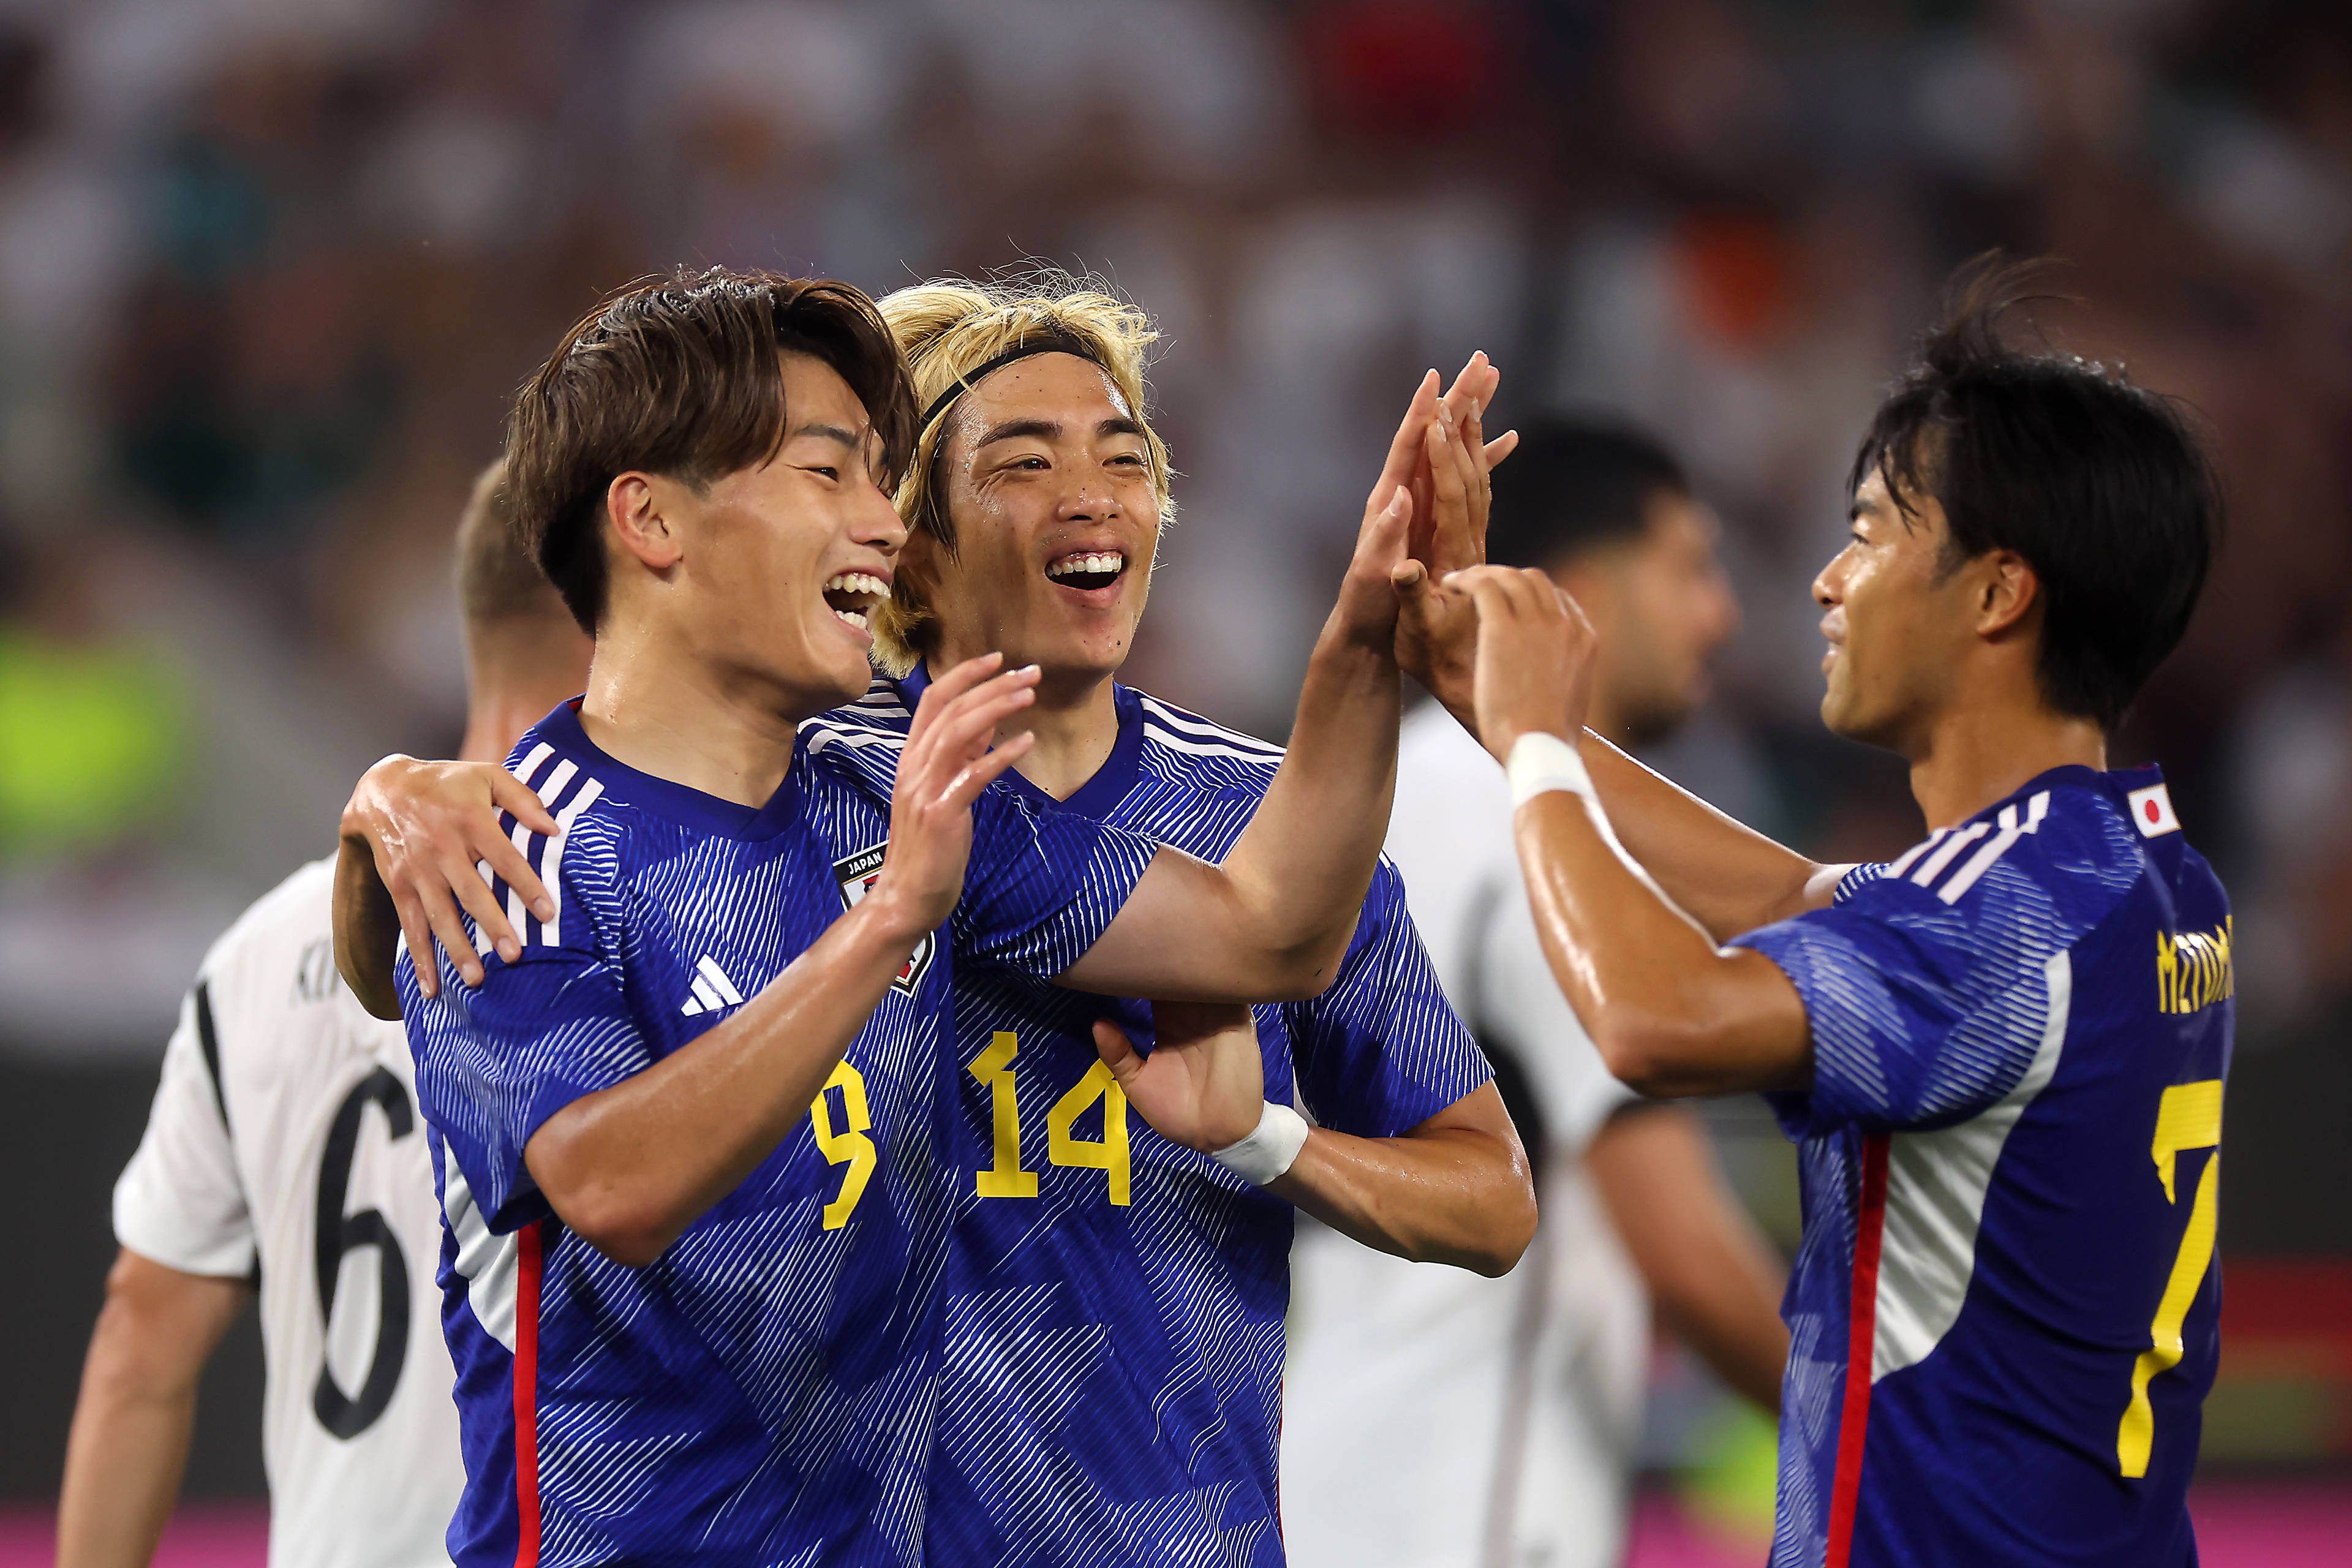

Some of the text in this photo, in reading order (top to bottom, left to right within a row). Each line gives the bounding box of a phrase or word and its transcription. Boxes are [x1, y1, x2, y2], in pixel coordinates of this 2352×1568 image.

[848, 852, 883, 875] JAPAN
[810, 1059, 877, 1231] 9
[967, 1031, 1131, 1206] 14
[314, 1065, 413, 1441] 6
[2117, 1079, 2223, 1479] 7
